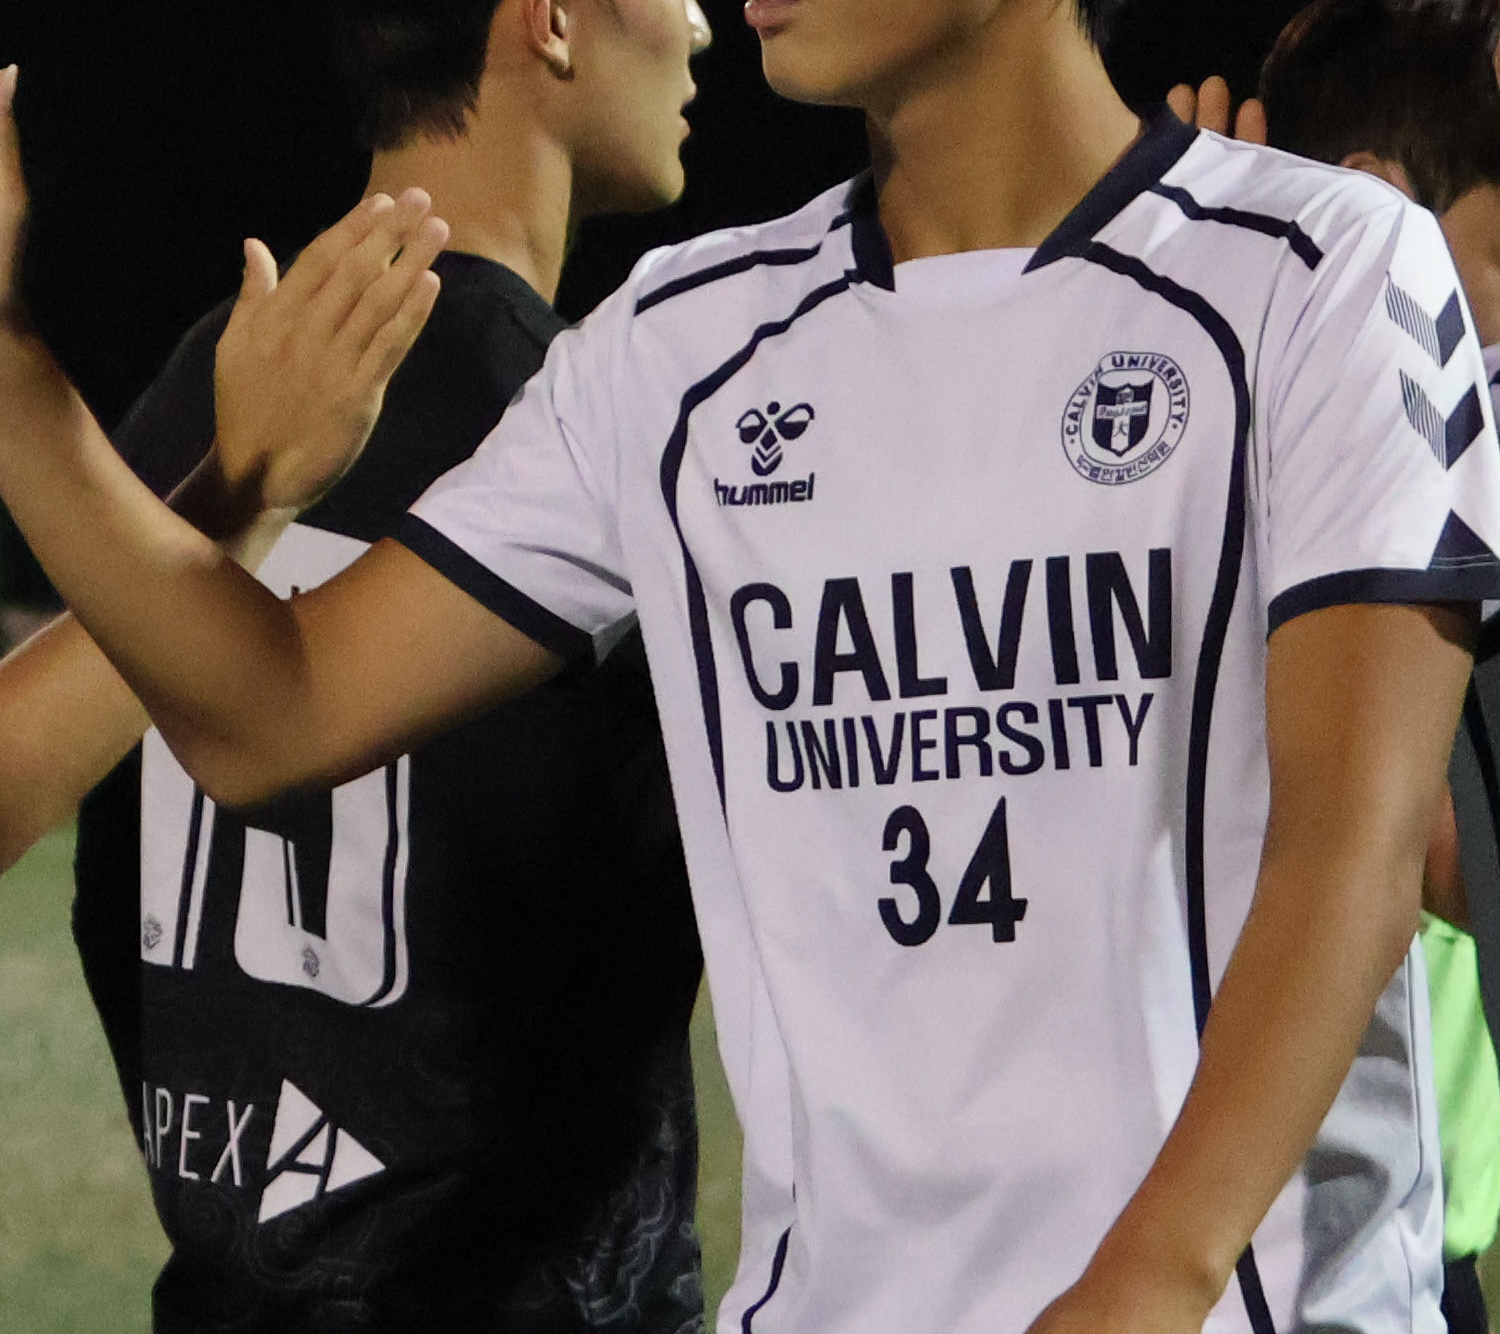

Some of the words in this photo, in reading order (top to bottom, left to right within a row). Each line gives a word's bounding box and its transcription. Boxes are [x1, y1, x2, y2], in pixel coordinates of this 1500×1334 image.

[1112, 355, 1186, 424] UNIVERSITY
[713, 472, 815, 506] hummel
[729, 547, 1173, 711] CALVIN
[765, 693, 1154, 794] UNIVERSITY
[878, 795, 1029, 947] 34
